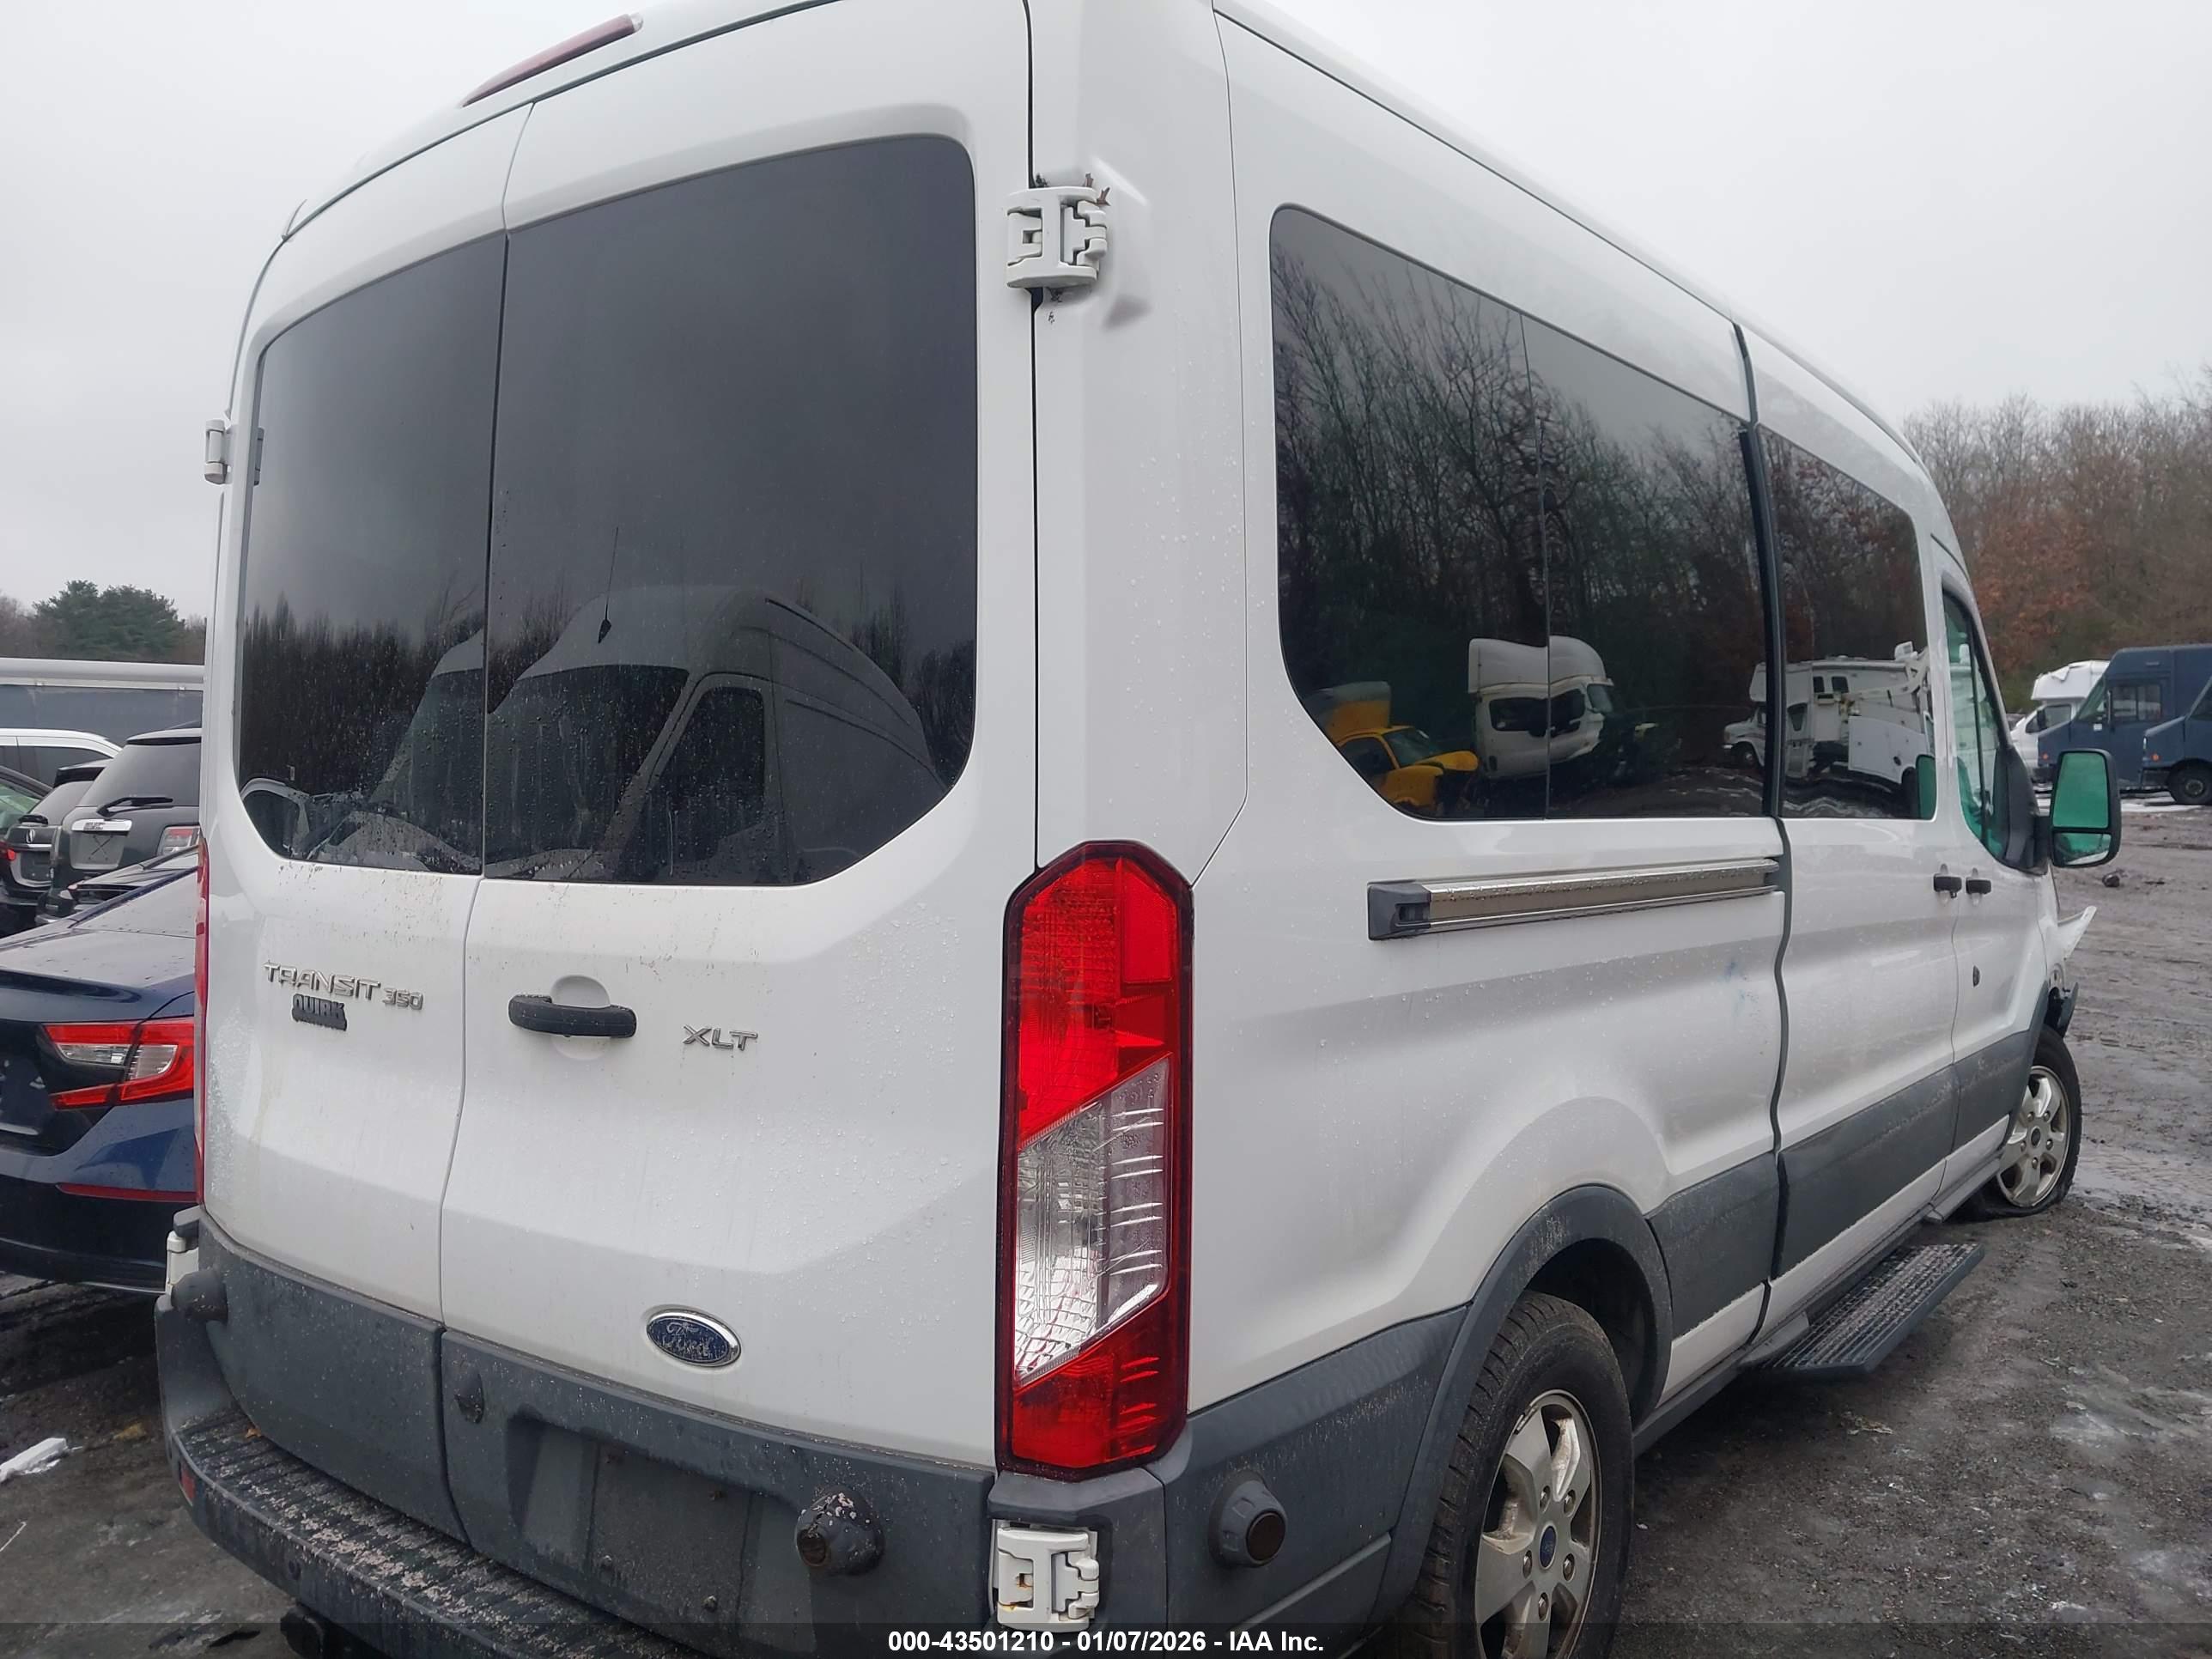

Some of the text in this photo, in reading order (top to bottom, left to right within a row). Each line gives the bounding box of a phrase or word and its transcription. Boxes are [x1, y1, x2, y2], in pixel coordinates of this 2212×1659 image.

[263, 960, 424, 1010] TRANSIT 350
[292, 994, 345, 1019] QUIRK
[683, 1024, 758, 1051] XLT
